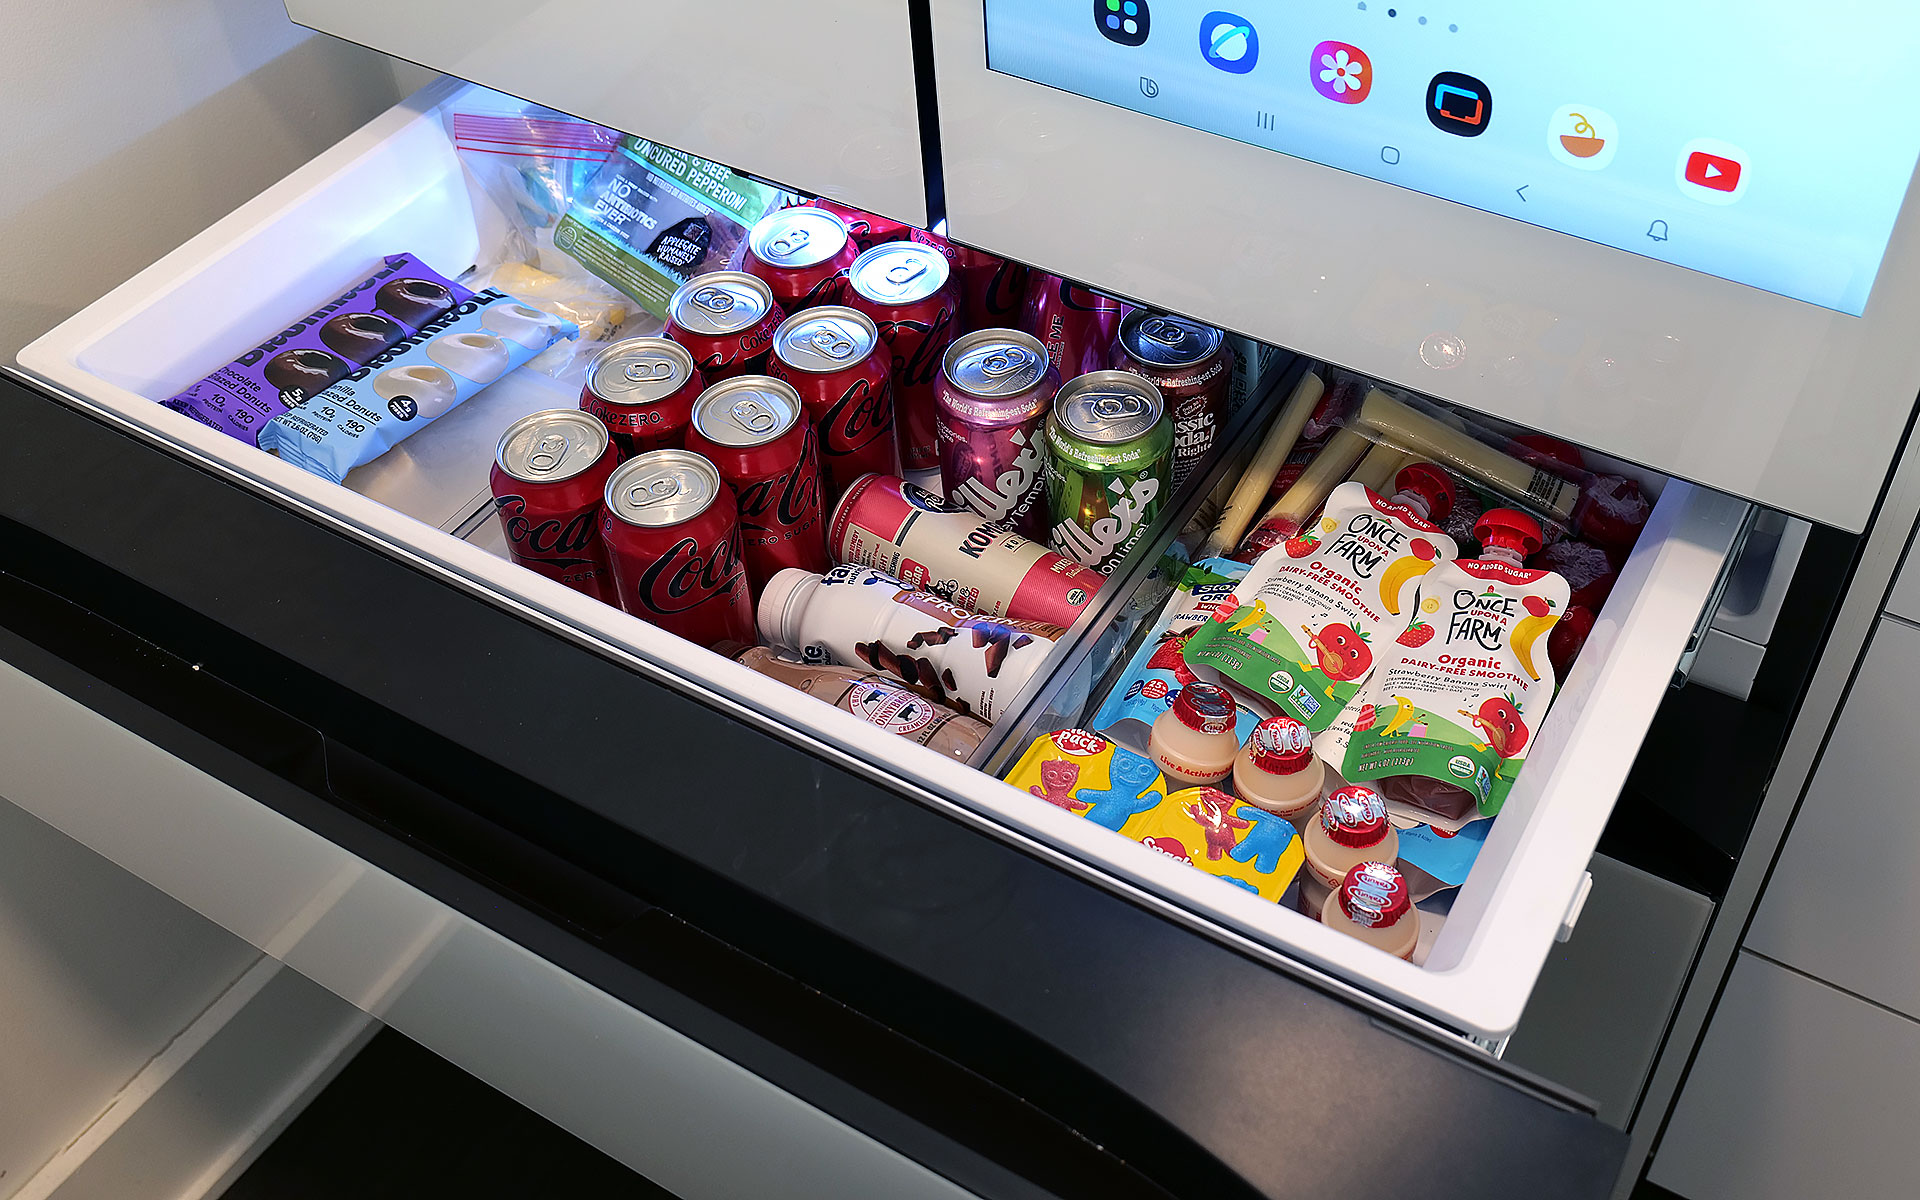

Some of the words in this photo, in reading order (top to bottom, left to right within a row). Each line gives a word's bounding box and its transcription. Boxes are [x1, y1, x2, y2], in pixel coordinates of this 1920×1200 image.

[633, 137, 687, 178] UNCURED
[687, 168, 748, 212] PEPPERONI
[607, 178, 632, 198] NO
[599, 189, 658, 231] ANTIBIOTICS
[656, 244, 696, 265] HUMANELY
[660, 235, 702, 256] APPLEGATE
[739, 326, 772, 352] Coke
[236, 386, 273, 414] Donuts
[345, 399, 383, 422] Donuts
[951, 397, 973, 417] World's
[234, 408, 255, 425] 190
[589, 399, 618, 425] Coke
[618, 411, 661, 427] ZERO
[345, 418, 366, 433] 190
[1055, 435, 1074, 456] World's
[1375, 498, 1387, 508] NO
[1347, 514, 1408, 553] ONCE
[1323, 532, 1383, 580] FARM
[1357, 535, 1380, 552] UPON
[1380, 547, 1389, 557] A
[563, 567, 605, 584] ZERO
[1309, 561, 1363, 596] Organic
[1467, 562, 1480, 570] NO
[1479, 562, 1504, 571] ADDED
[1503, 566, 1529, 579] SUGAR
[1279, 565, 1330, 587] DAIRY-FREE
[1329, 582, 1381, 623] SMOOTHIE
[1304, 584, 1335, 604] Banana
[1334, 600, 1358, 620] Swirl
[1453, 589, 1518, 618] ONCE
[920, 596, 1021, 627] PROTEIN
[1470, 609, 1500, 622] UPON
[1499, 617, 1508, 626] A
[1445, 610, 1503, 652] FARM
[1220, 653, 1244, 672] (113g)
[1438, 654, 1502, 670] Organic
[1388, 668, 1442, 682] Strawberry
[1443, 675, 1479, 688] Banana
[1481, 681, 1508, 691] Swirl
[1400, 657, 1467, 676] DAIRY-FREE
[1468, 669, 1529, 692] SMOOTHIE
[1450, 684, 1480, 692] COCONUT
[1160, 755, 1176, 770] Live
[1183, 767, 1212, 778] Active
